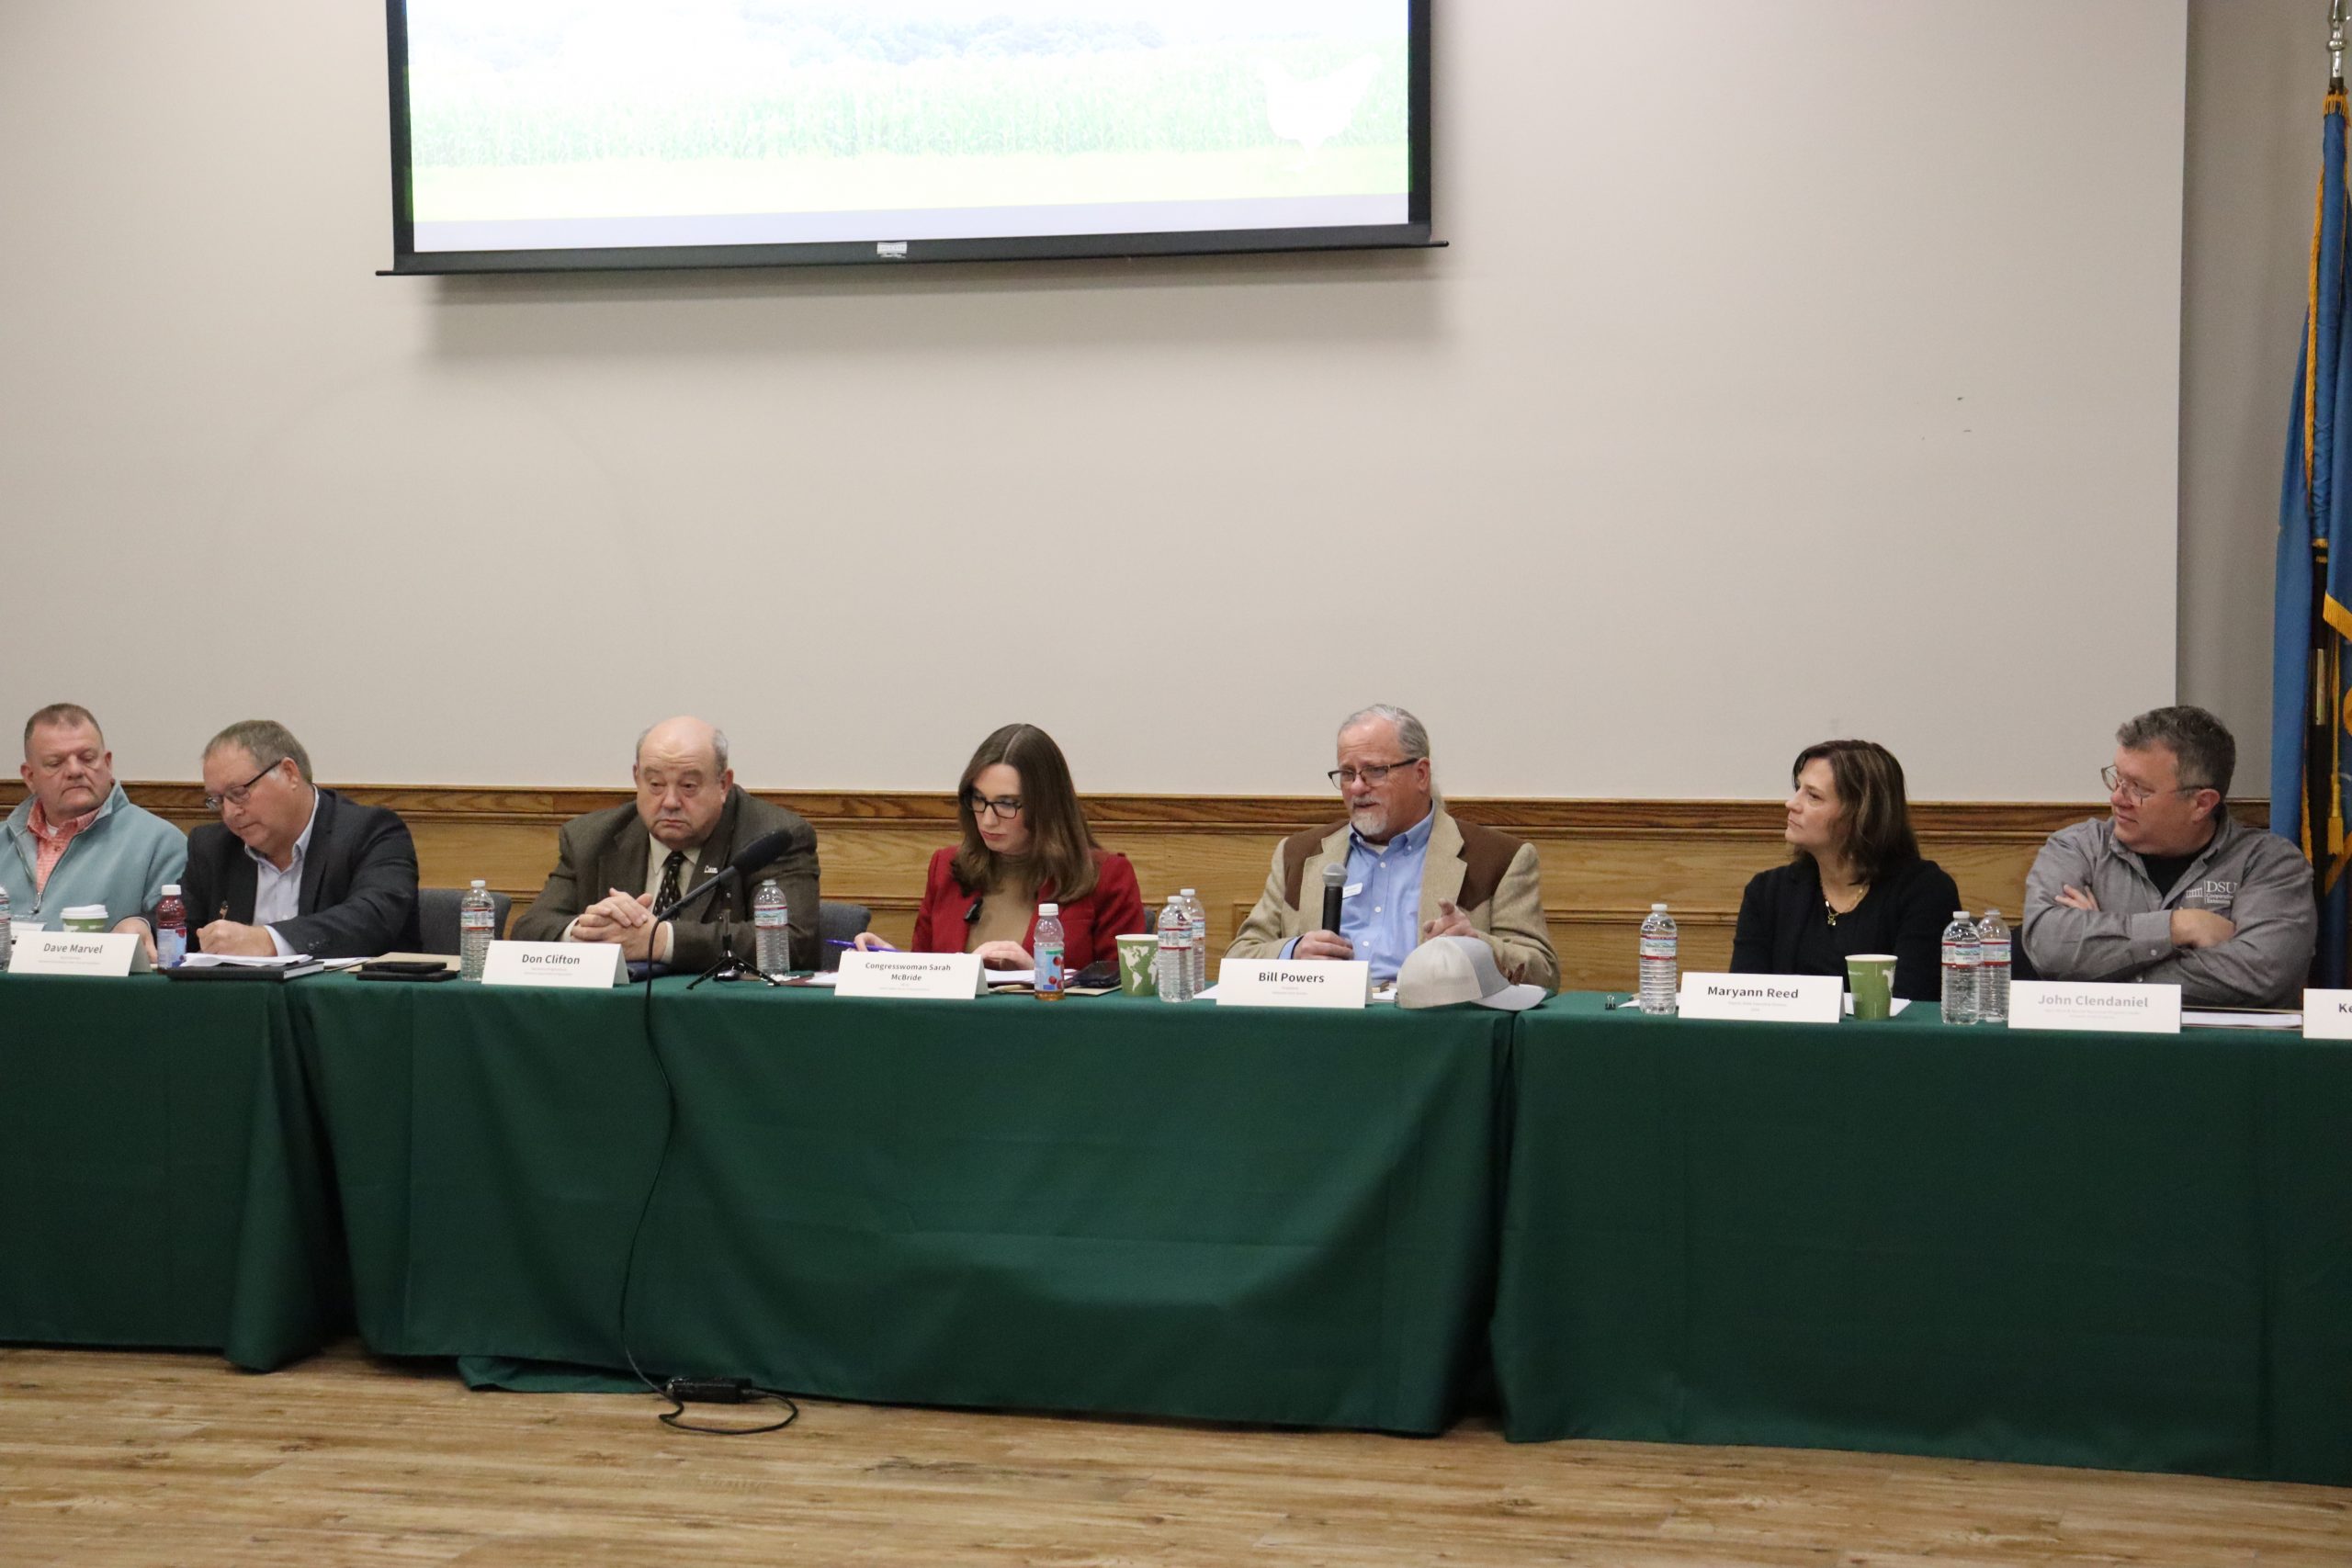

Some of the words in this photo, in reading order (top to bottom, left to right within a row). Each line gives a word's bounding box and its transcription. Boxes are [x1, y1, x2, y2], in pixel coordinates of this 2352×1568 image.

[2206, 880, 2238, 894] DSU
[43, 942, 68, 953] Dave
[69, 943, 104, 954] Marvel
[522, 953, 542, 964] Don
[545, 953, 581, 964] Clifton
[865, 962, 928, 972] Congresswoman
[929, 962, 952, 971] Sarah
[1259, 971, 1278, 982] Bill
[1281, 973, 1325, 983] Powers
[1707, 986, 1763, 998] Maryann
[1767, 987, 1799, 998] Reed
[2038, 994, 2072, 1006] John
[2075, 995, 2148, 1008] Clendaniel
